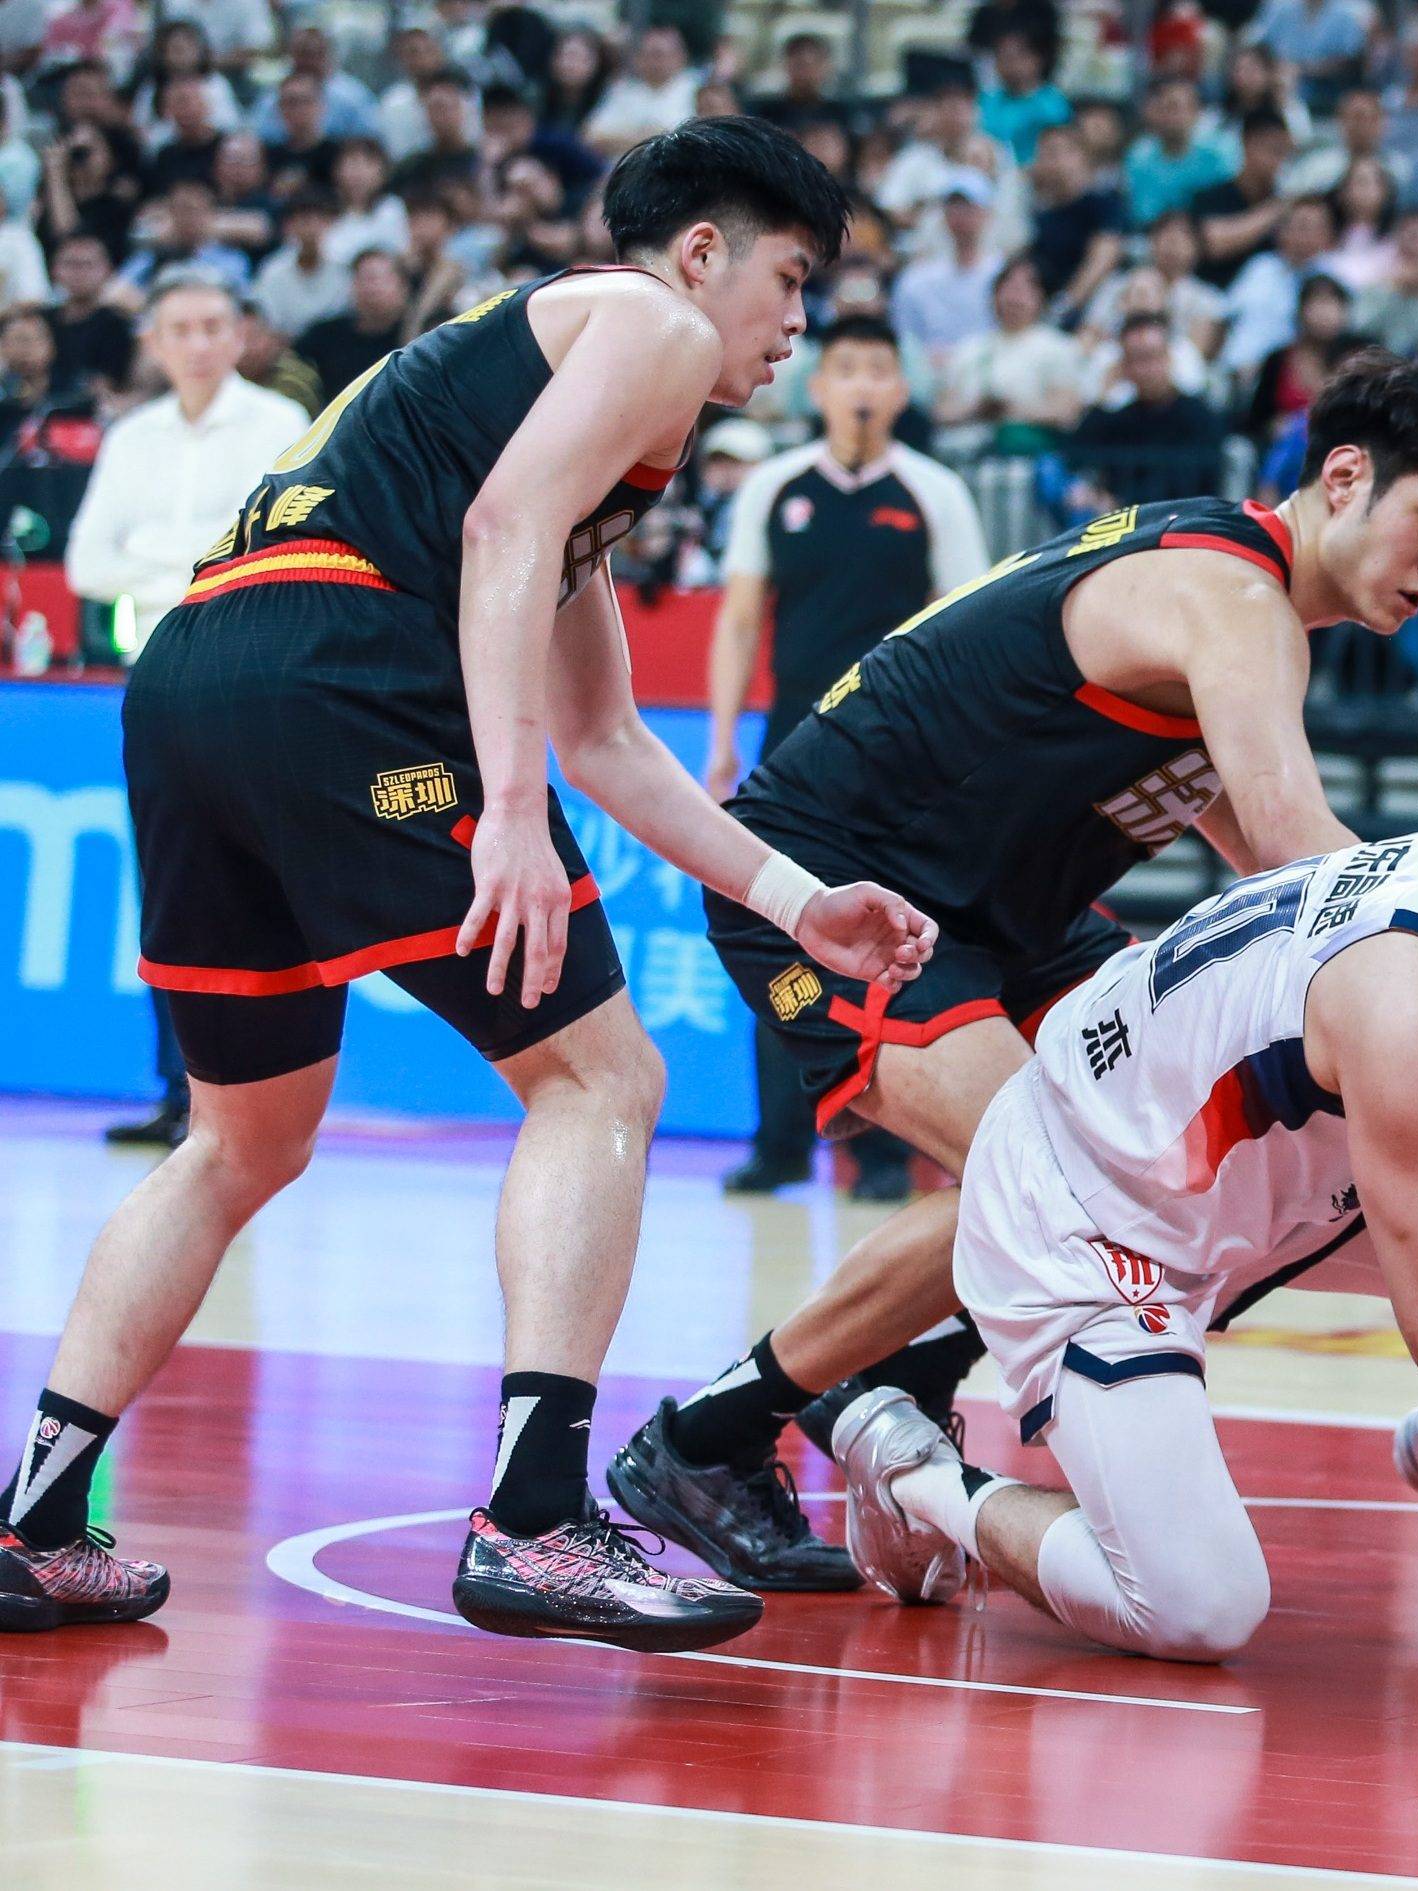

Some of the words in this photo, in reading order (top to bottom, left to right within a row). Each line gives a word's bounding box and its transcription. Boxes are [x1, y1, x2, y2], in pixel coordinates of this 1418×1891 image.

[375, 776, 453, 814] 深圳
[382, 767, 440, 788] SZLEOPARDS
[1306, 839, 1415, 939] 东高速
[1081, 980, 1132, 1081] 杰
